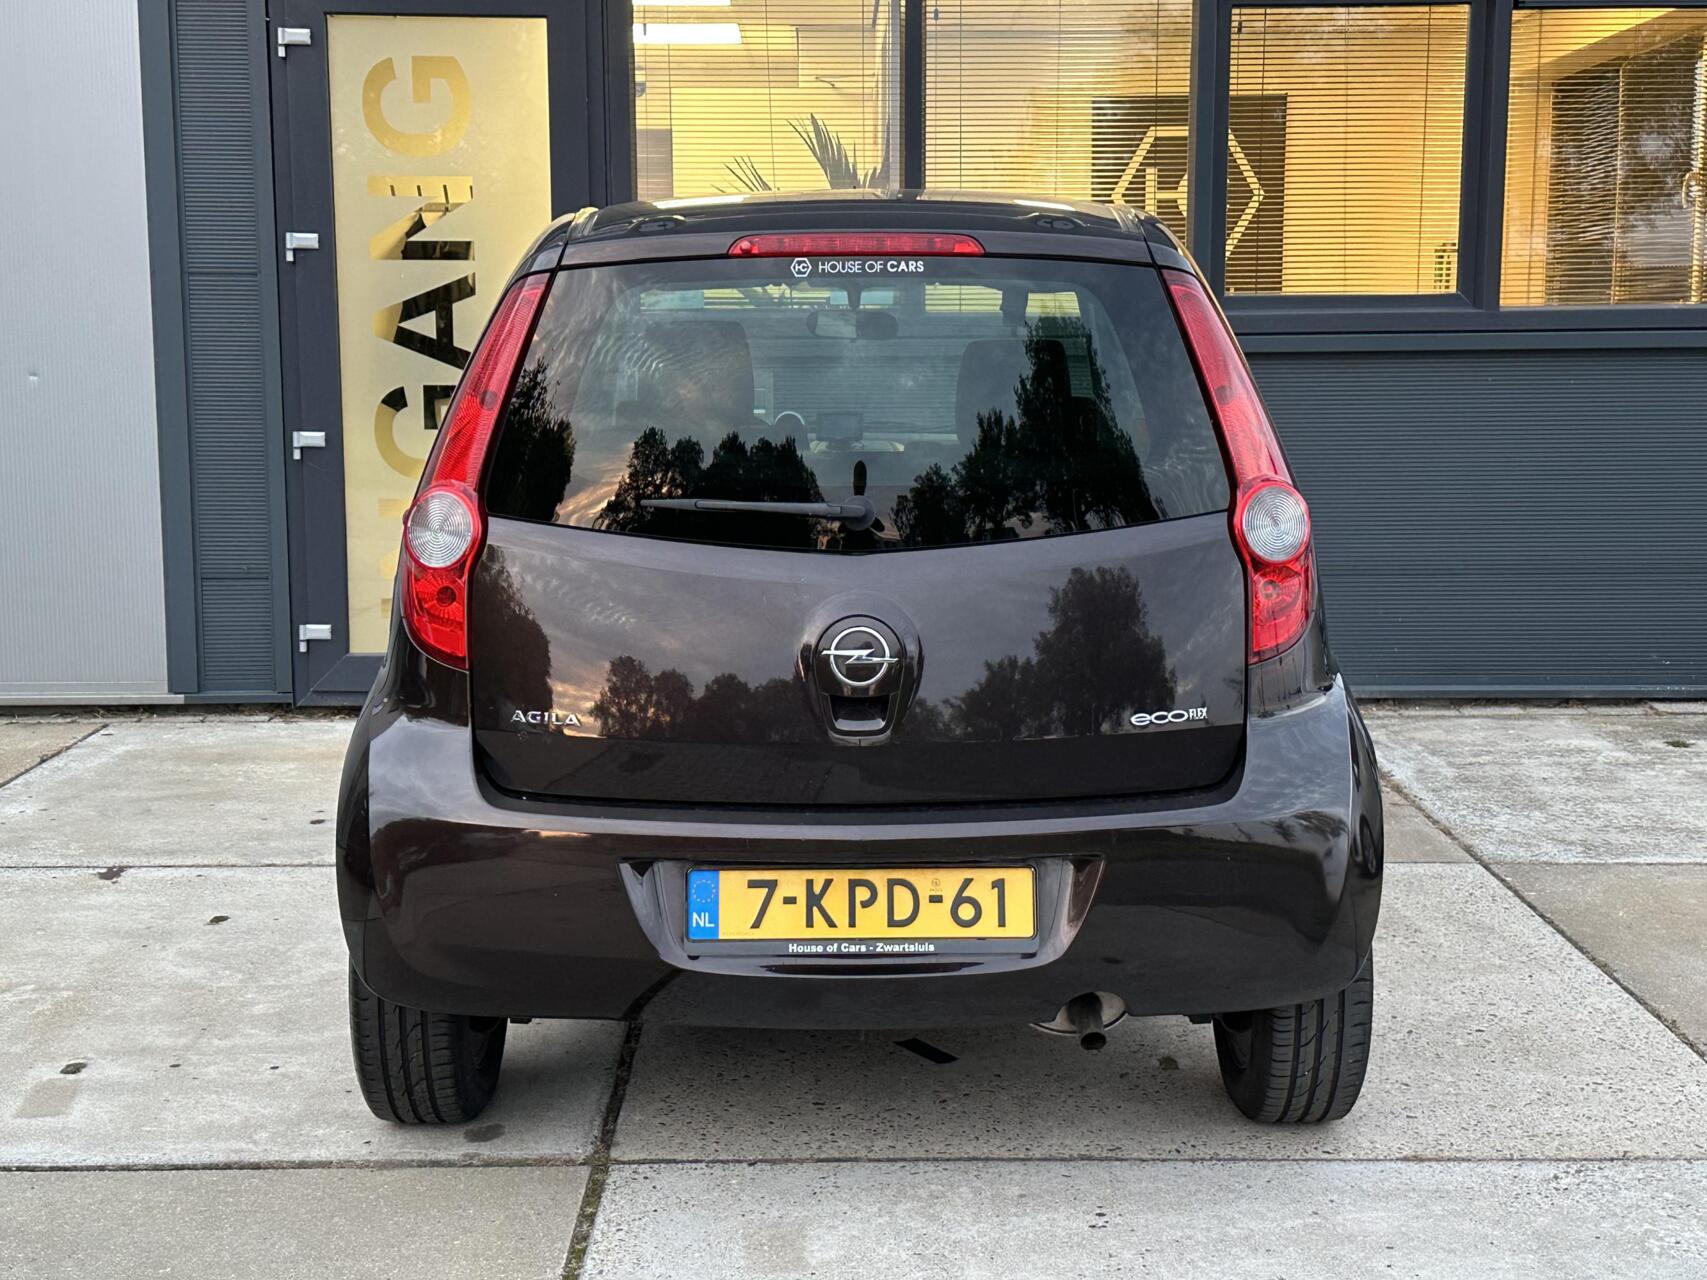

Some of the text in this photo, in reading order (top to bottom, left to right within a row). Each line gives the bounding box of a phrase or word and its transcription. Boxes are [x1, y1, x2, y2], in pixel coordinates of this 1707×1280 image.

[818, 261, 862, 273] HOUSE
[865, 261, 884, 273] OF
[886, 260, 925, 272] CARS
[361, 55, 475, 618] GANG
[510, 710, 582, 727] AGILA
[747, 878, 1006, 929] 7-KPD-61
[692, 912, 715, 928] NL
[788, 943, 823, 953] House
[826, 943, 838, 953] of
[840, 943, 867, 953] Cars
[875, 942, 935, 952] Zwartsluis
